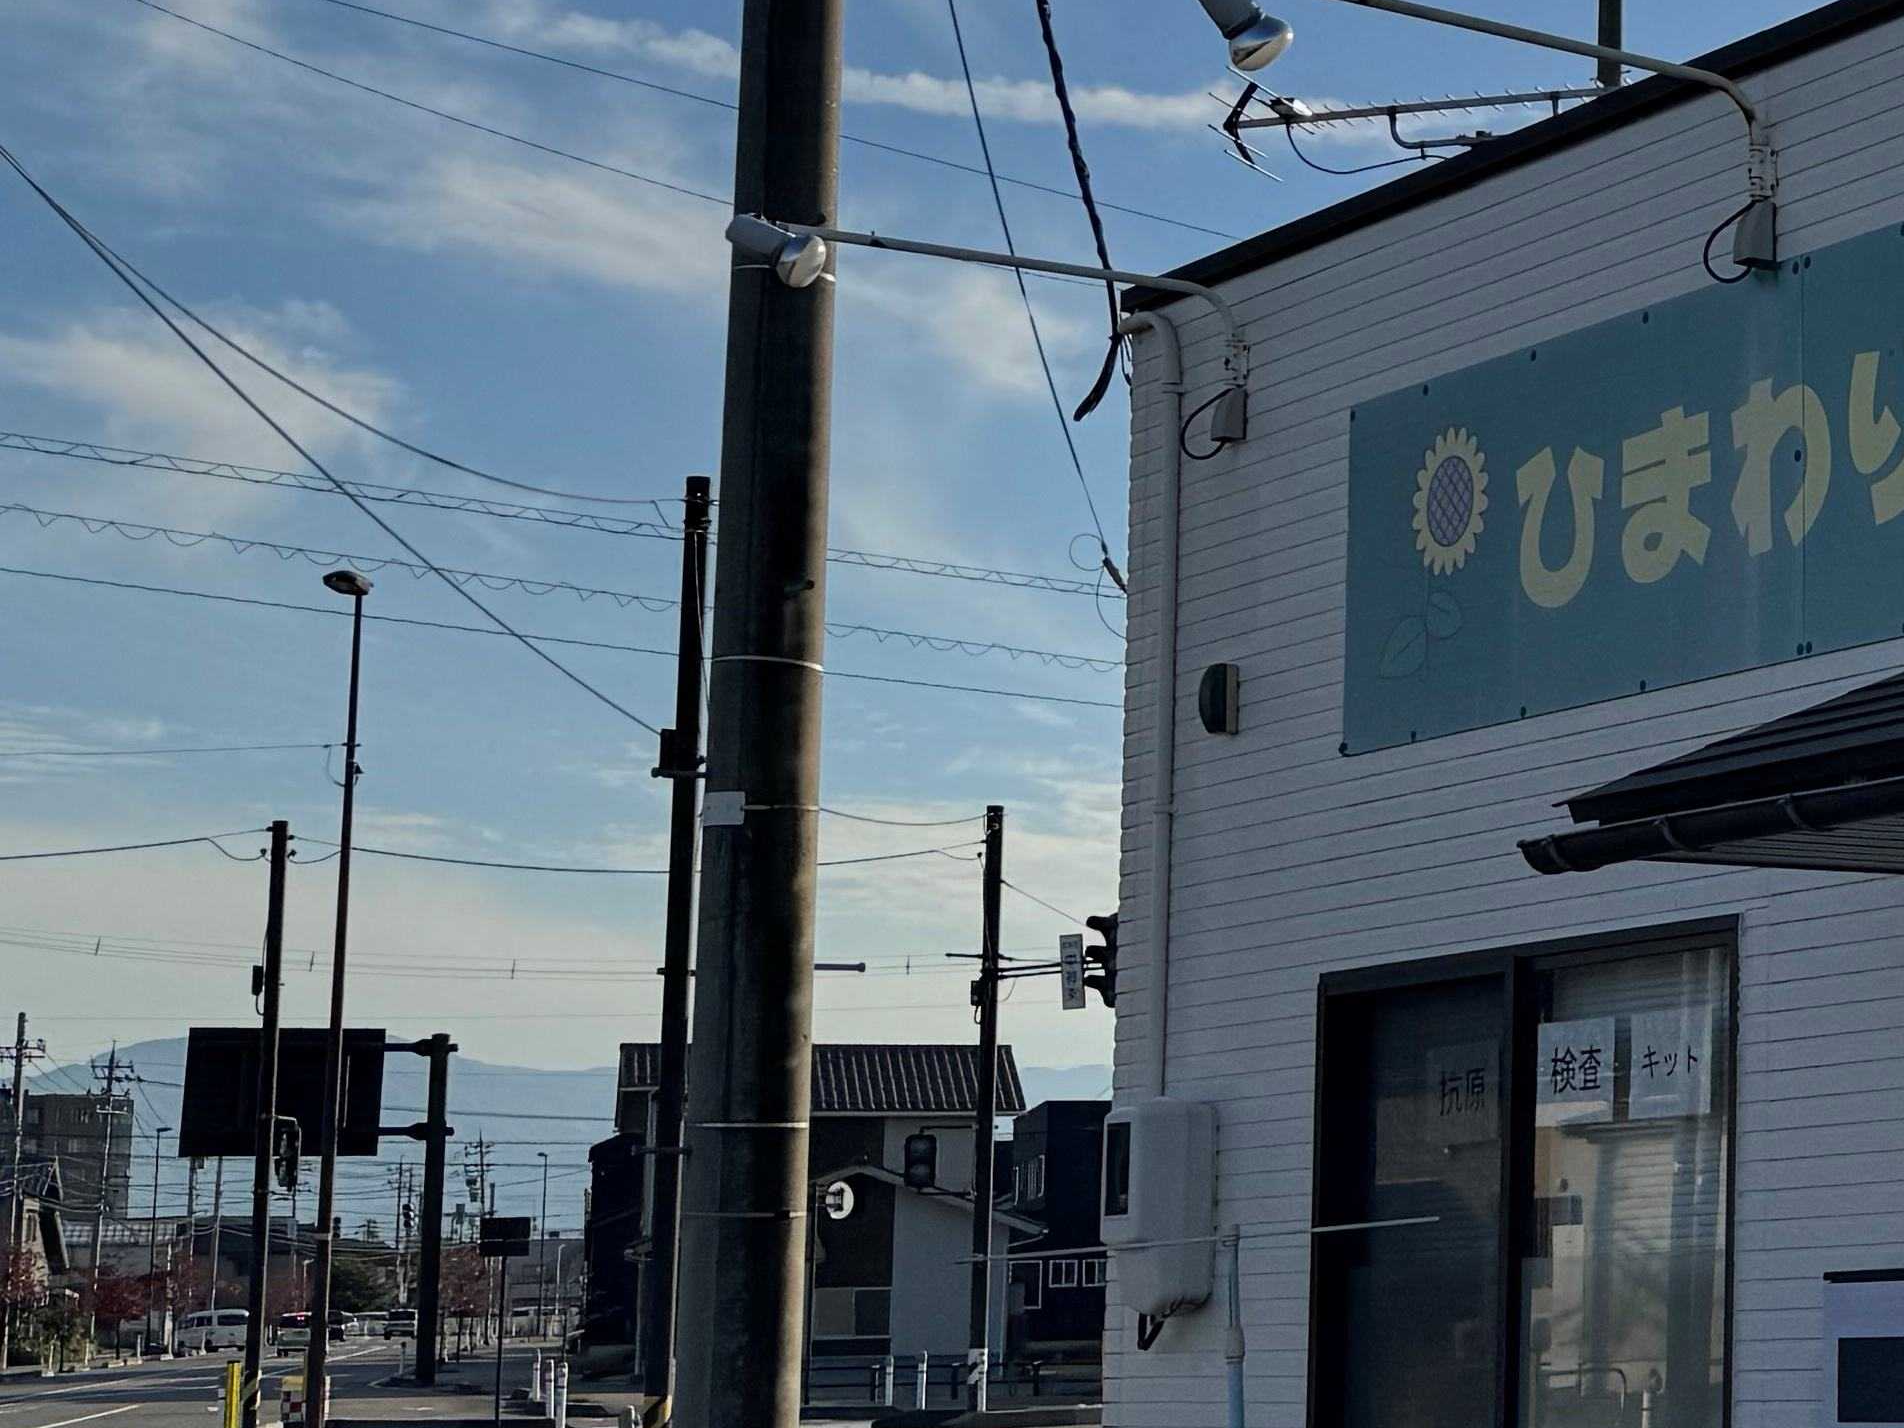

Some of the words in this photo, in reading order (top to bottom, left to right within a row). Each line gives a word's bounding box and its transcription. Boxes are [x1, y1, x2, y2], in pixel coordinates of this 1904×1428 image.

[1551, 1047, 1603, 1094] 検査
[1641, 1044, 1699, 1077] キット
